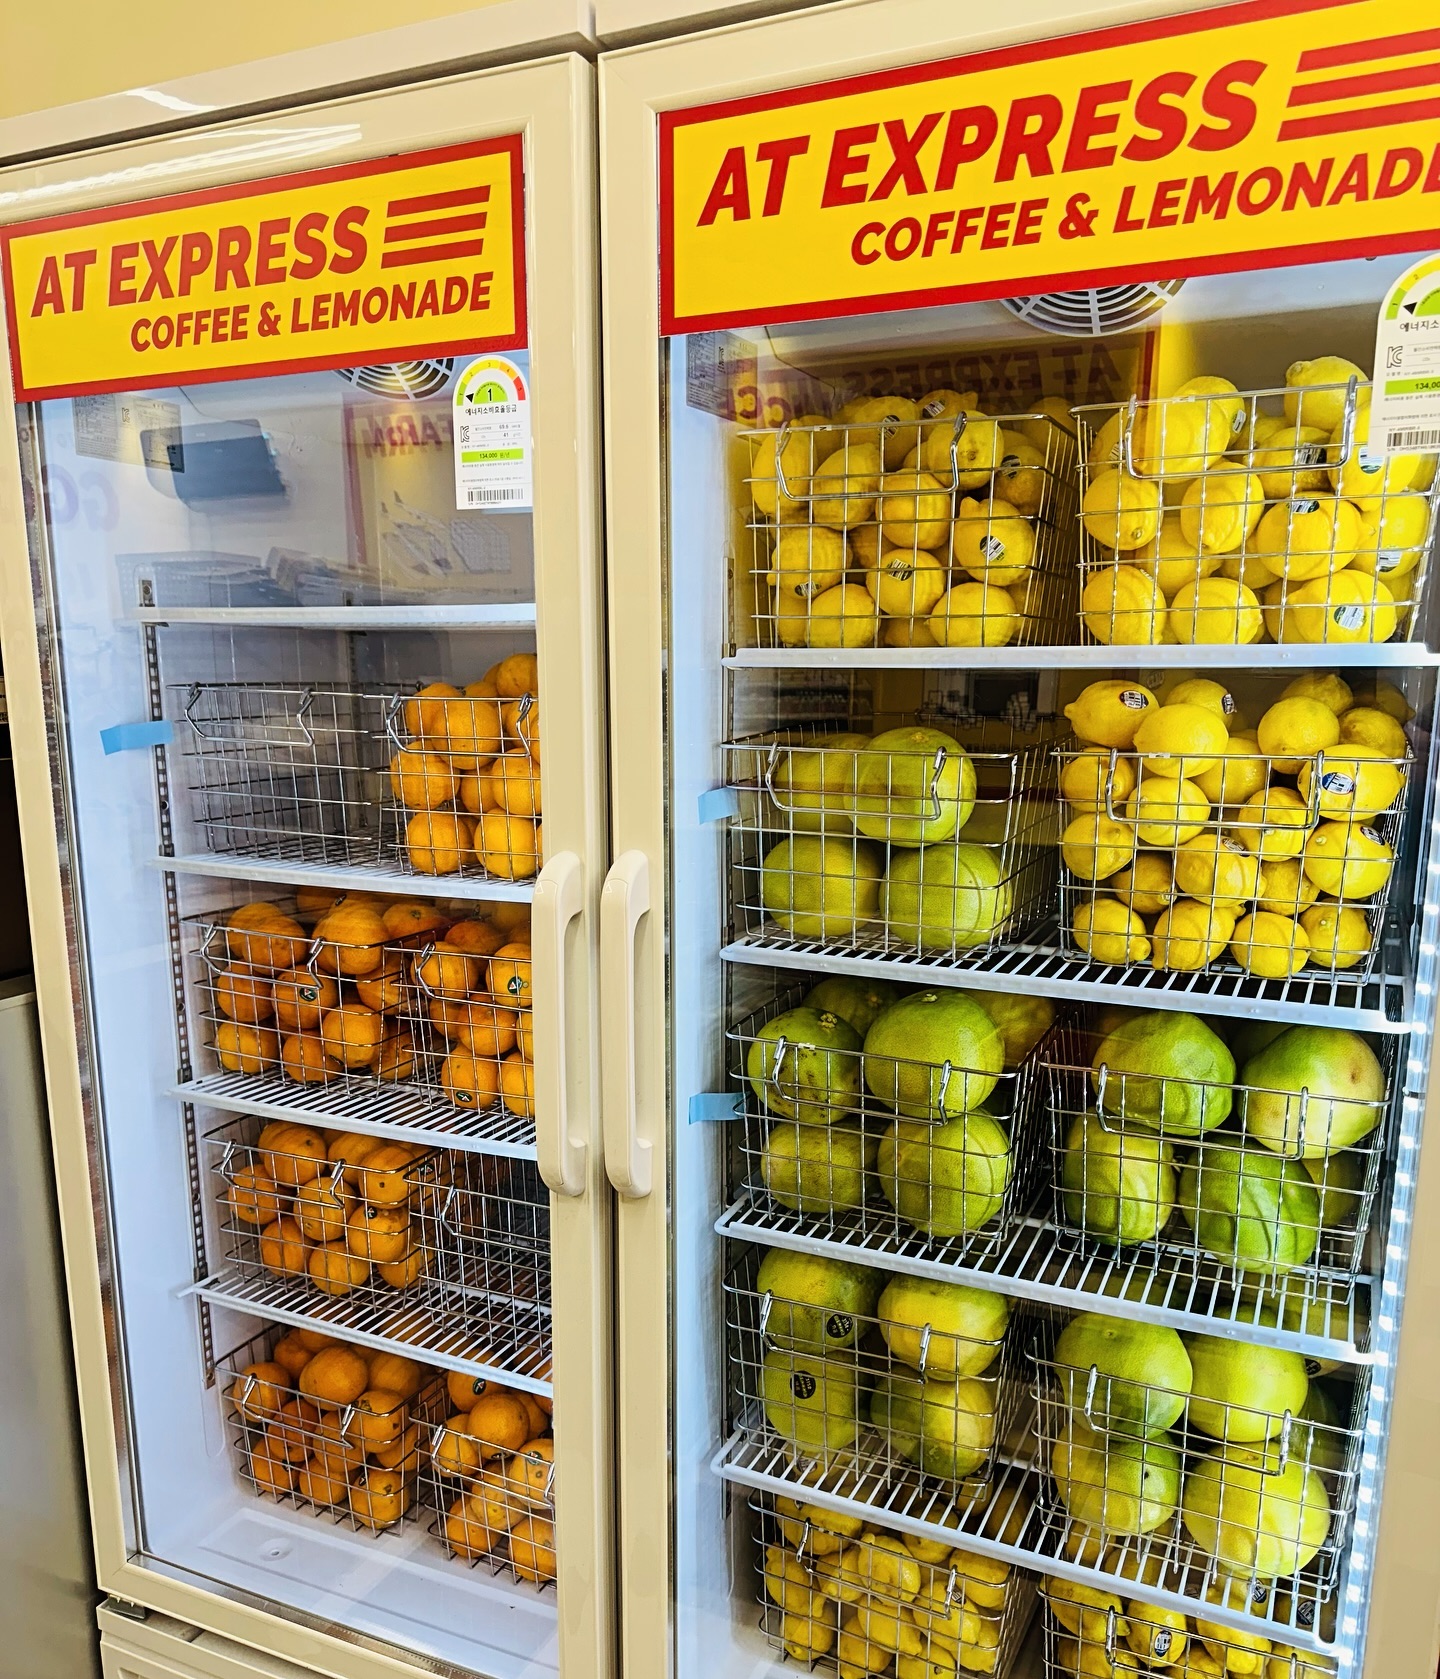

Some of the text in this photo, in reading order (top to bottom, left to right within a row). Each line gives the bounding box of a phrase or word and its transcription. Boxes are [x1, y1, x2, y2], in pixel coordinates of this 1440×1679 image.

[697, 60, 1267, 226] AT EXPRESS
[32, 206, 370, 318] AT EXPRESS
[851, 203, 1049, 265] COFFEE
[1059, 193, 1098, 239] &
[131, 271, 494, 353] COFFEE & LEMONADE
[465, 404, 517, 416] 에너지소비효율등급
[487, 388, 492, 401] 1
